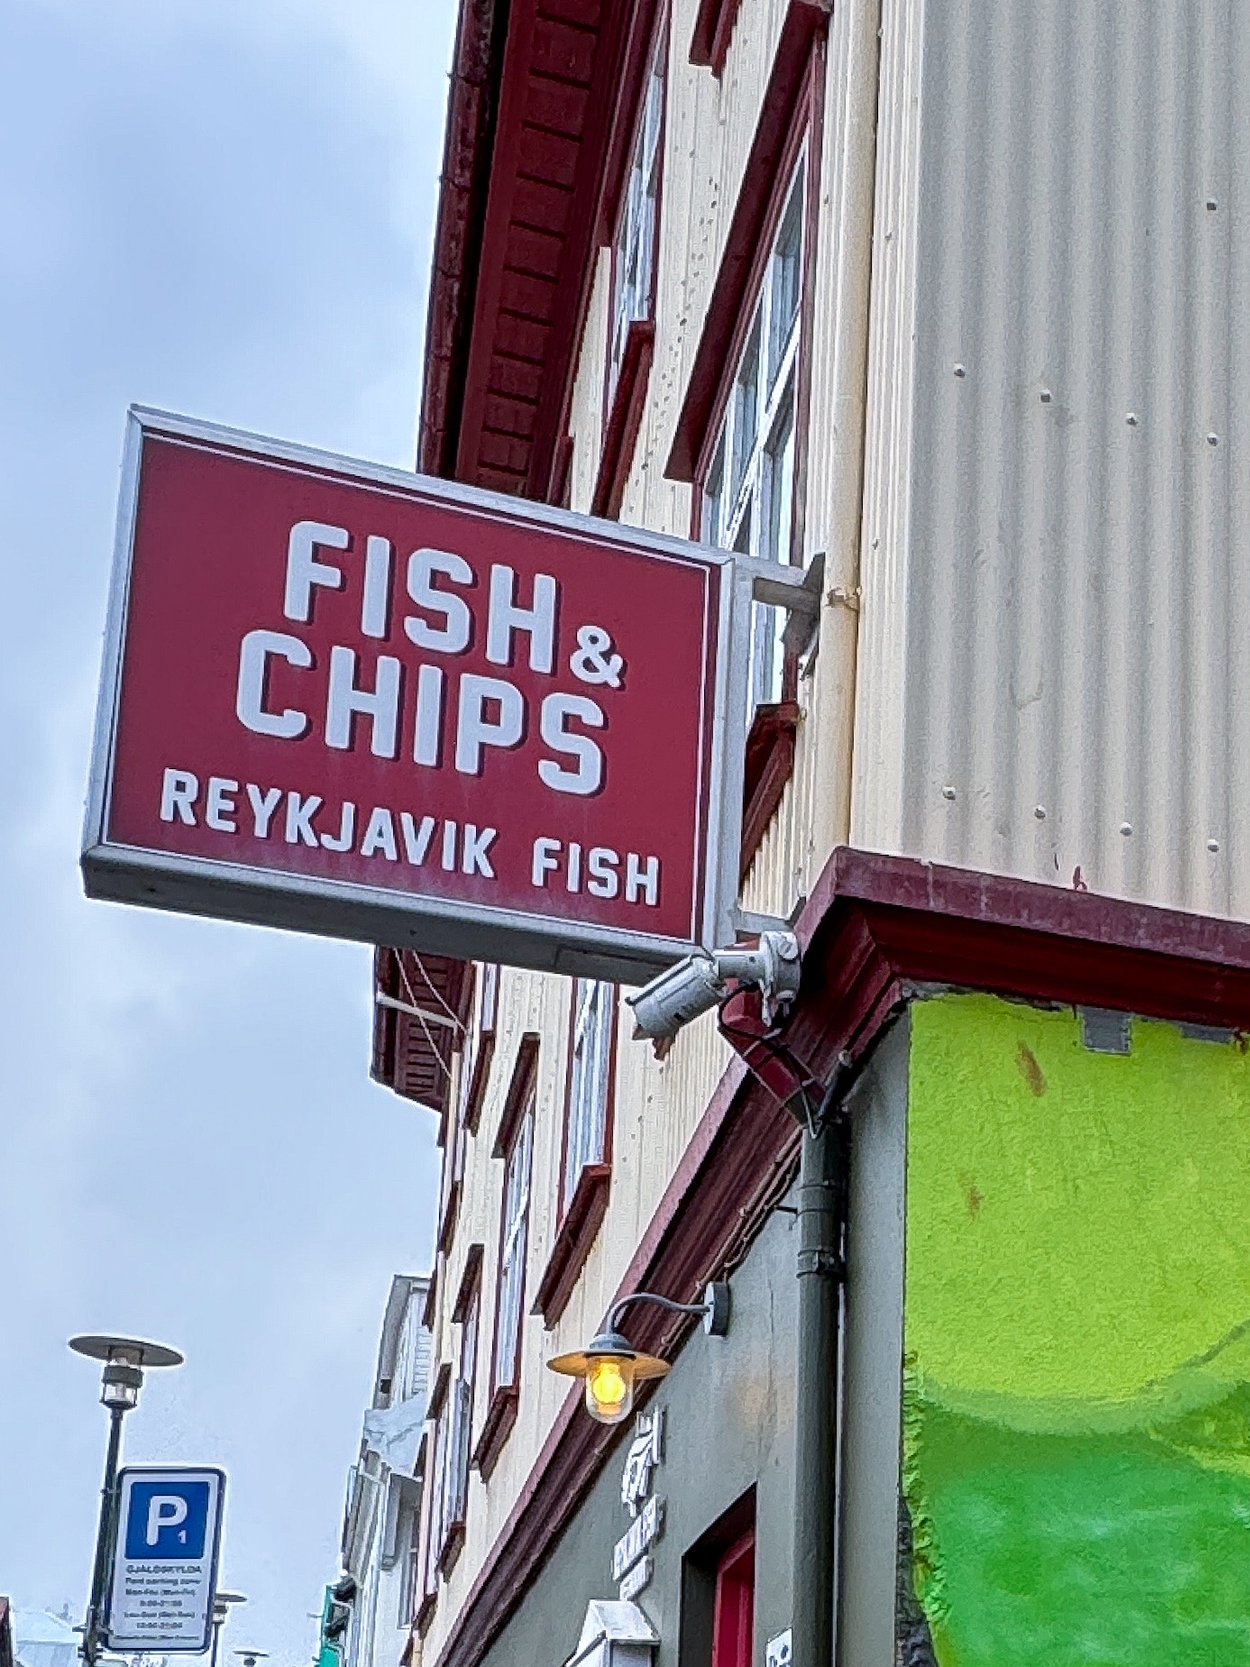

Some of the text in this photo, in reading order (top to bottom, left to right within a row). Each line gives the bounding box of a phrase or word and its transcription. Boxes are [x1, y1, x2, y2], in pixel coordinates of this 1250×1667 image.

[284, 521, 556, 674] FISH
[236, 629, 605, 796] CHIPS
[160, 767, 660, 907] REYKJAVIK FISH
[146, 1495, 188, 1546] P
